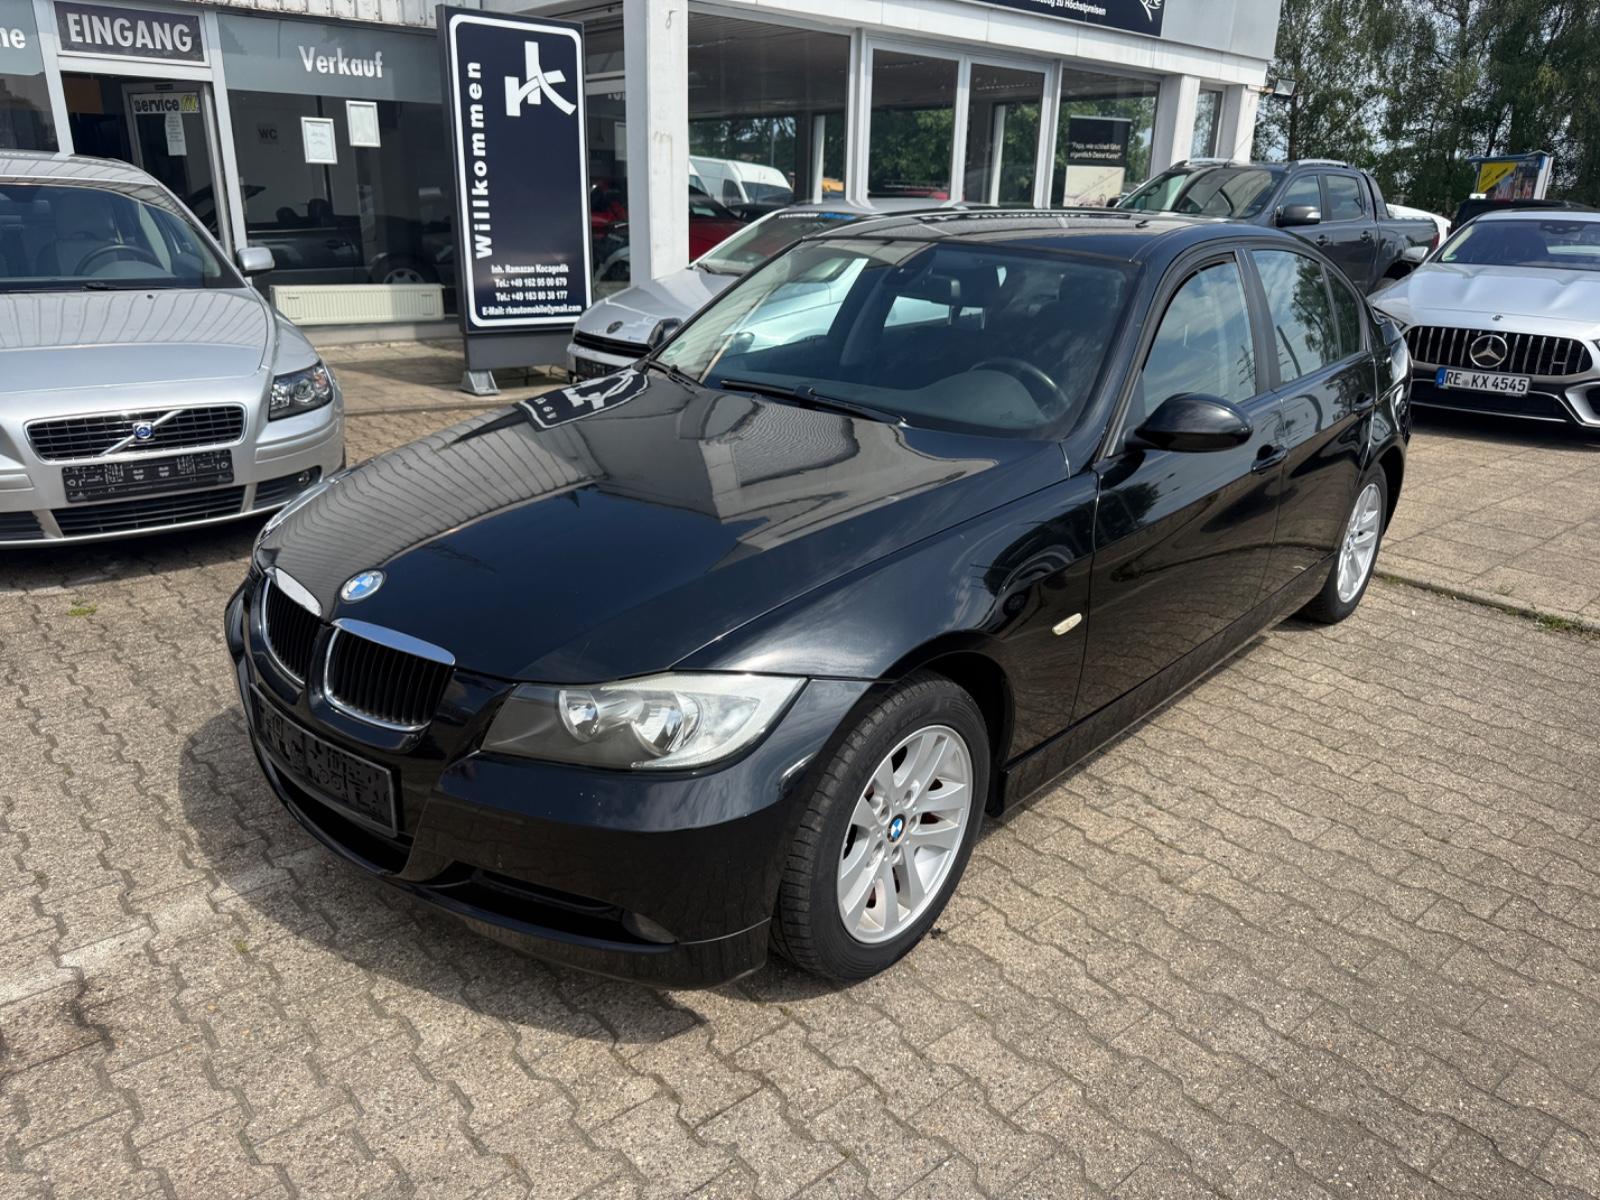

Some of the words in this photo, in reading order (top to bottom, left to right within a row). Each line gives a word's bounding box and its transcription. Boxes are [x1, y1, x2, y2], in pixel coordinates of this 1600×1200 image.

[66, 13, 193, 52] EINGANG
[299, 46, 383, 79] Verkauf
[134, 99, 180, 112] service
[257, 128, 278, 139] WC
[467, 62, 493, 259] Willkommen
[511, 278, 523, 287] +49
[511, 291, 524, 300] +49
[1445, 371, 1462, 386] RE
[1471, 374, 1490, 389] KX
[1491, 377, 1527, 393] 4545
